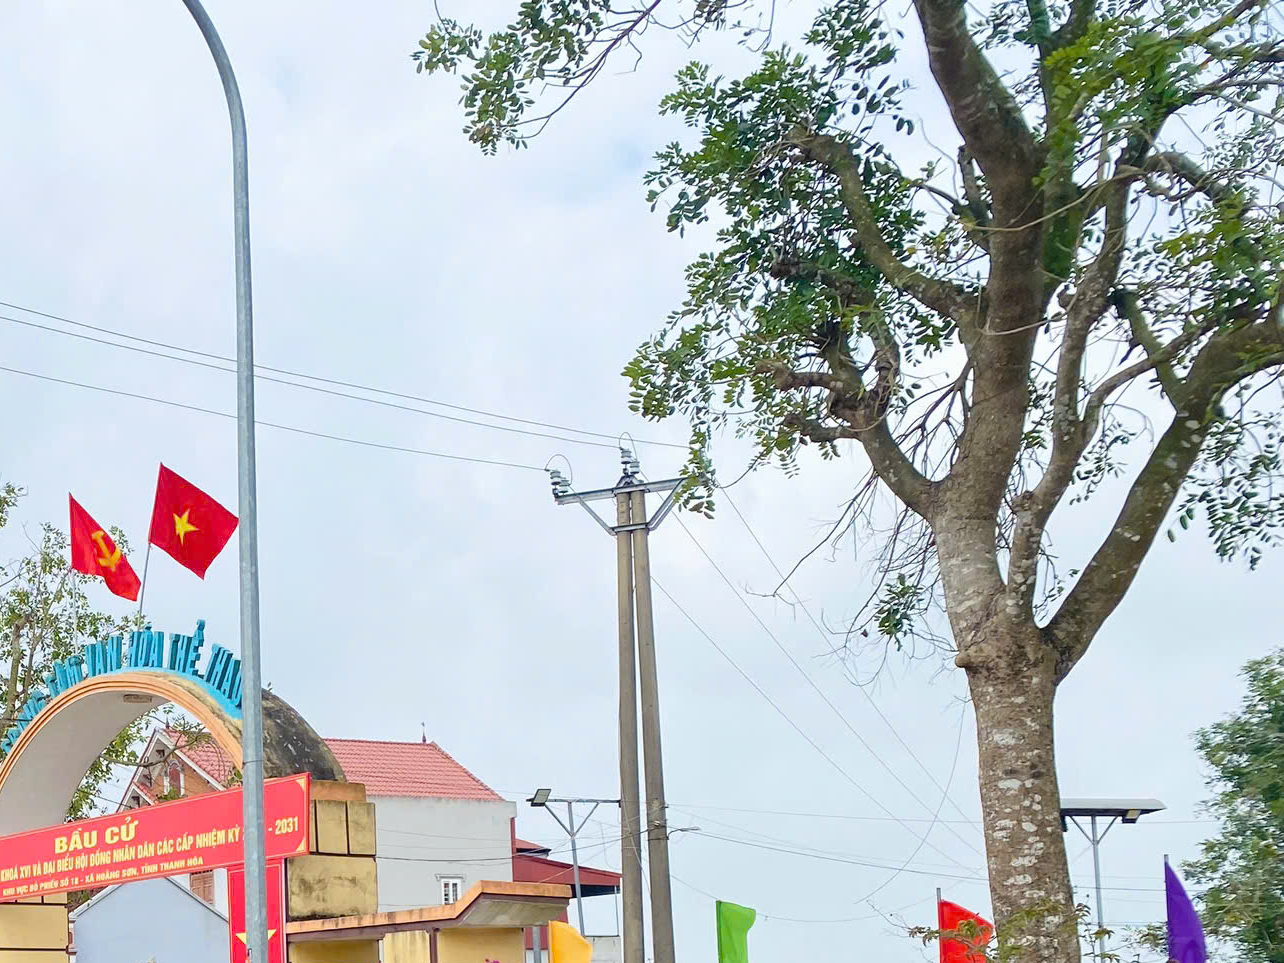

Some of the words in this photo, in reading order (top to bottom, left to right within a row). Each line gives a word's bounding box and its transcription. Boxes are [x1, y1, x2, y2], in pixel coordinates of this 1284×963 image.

[19, 864, 31, 879] XVI
[57, 853, 74, 872] BIỂU
[75, 853, 88, 871] HỘI
[89, 848, 111, 867] ĐỒNG
[113, 845, 135, 863] NHÂN
[138, 841, 155, 858] DÂN
[156, 836, 174, 854] CÁC
[176, 831, 193, 852] CẤP
[195, 827, 226, 849] NHIỆM
[227, 824, 241, 844] KỲ
[275, 816, 299, 835] 2031
[54, 827, 98, 855] BẦU
[105, 816, 139, 844] CỬ
[160, 859, 185, 871] THANH
